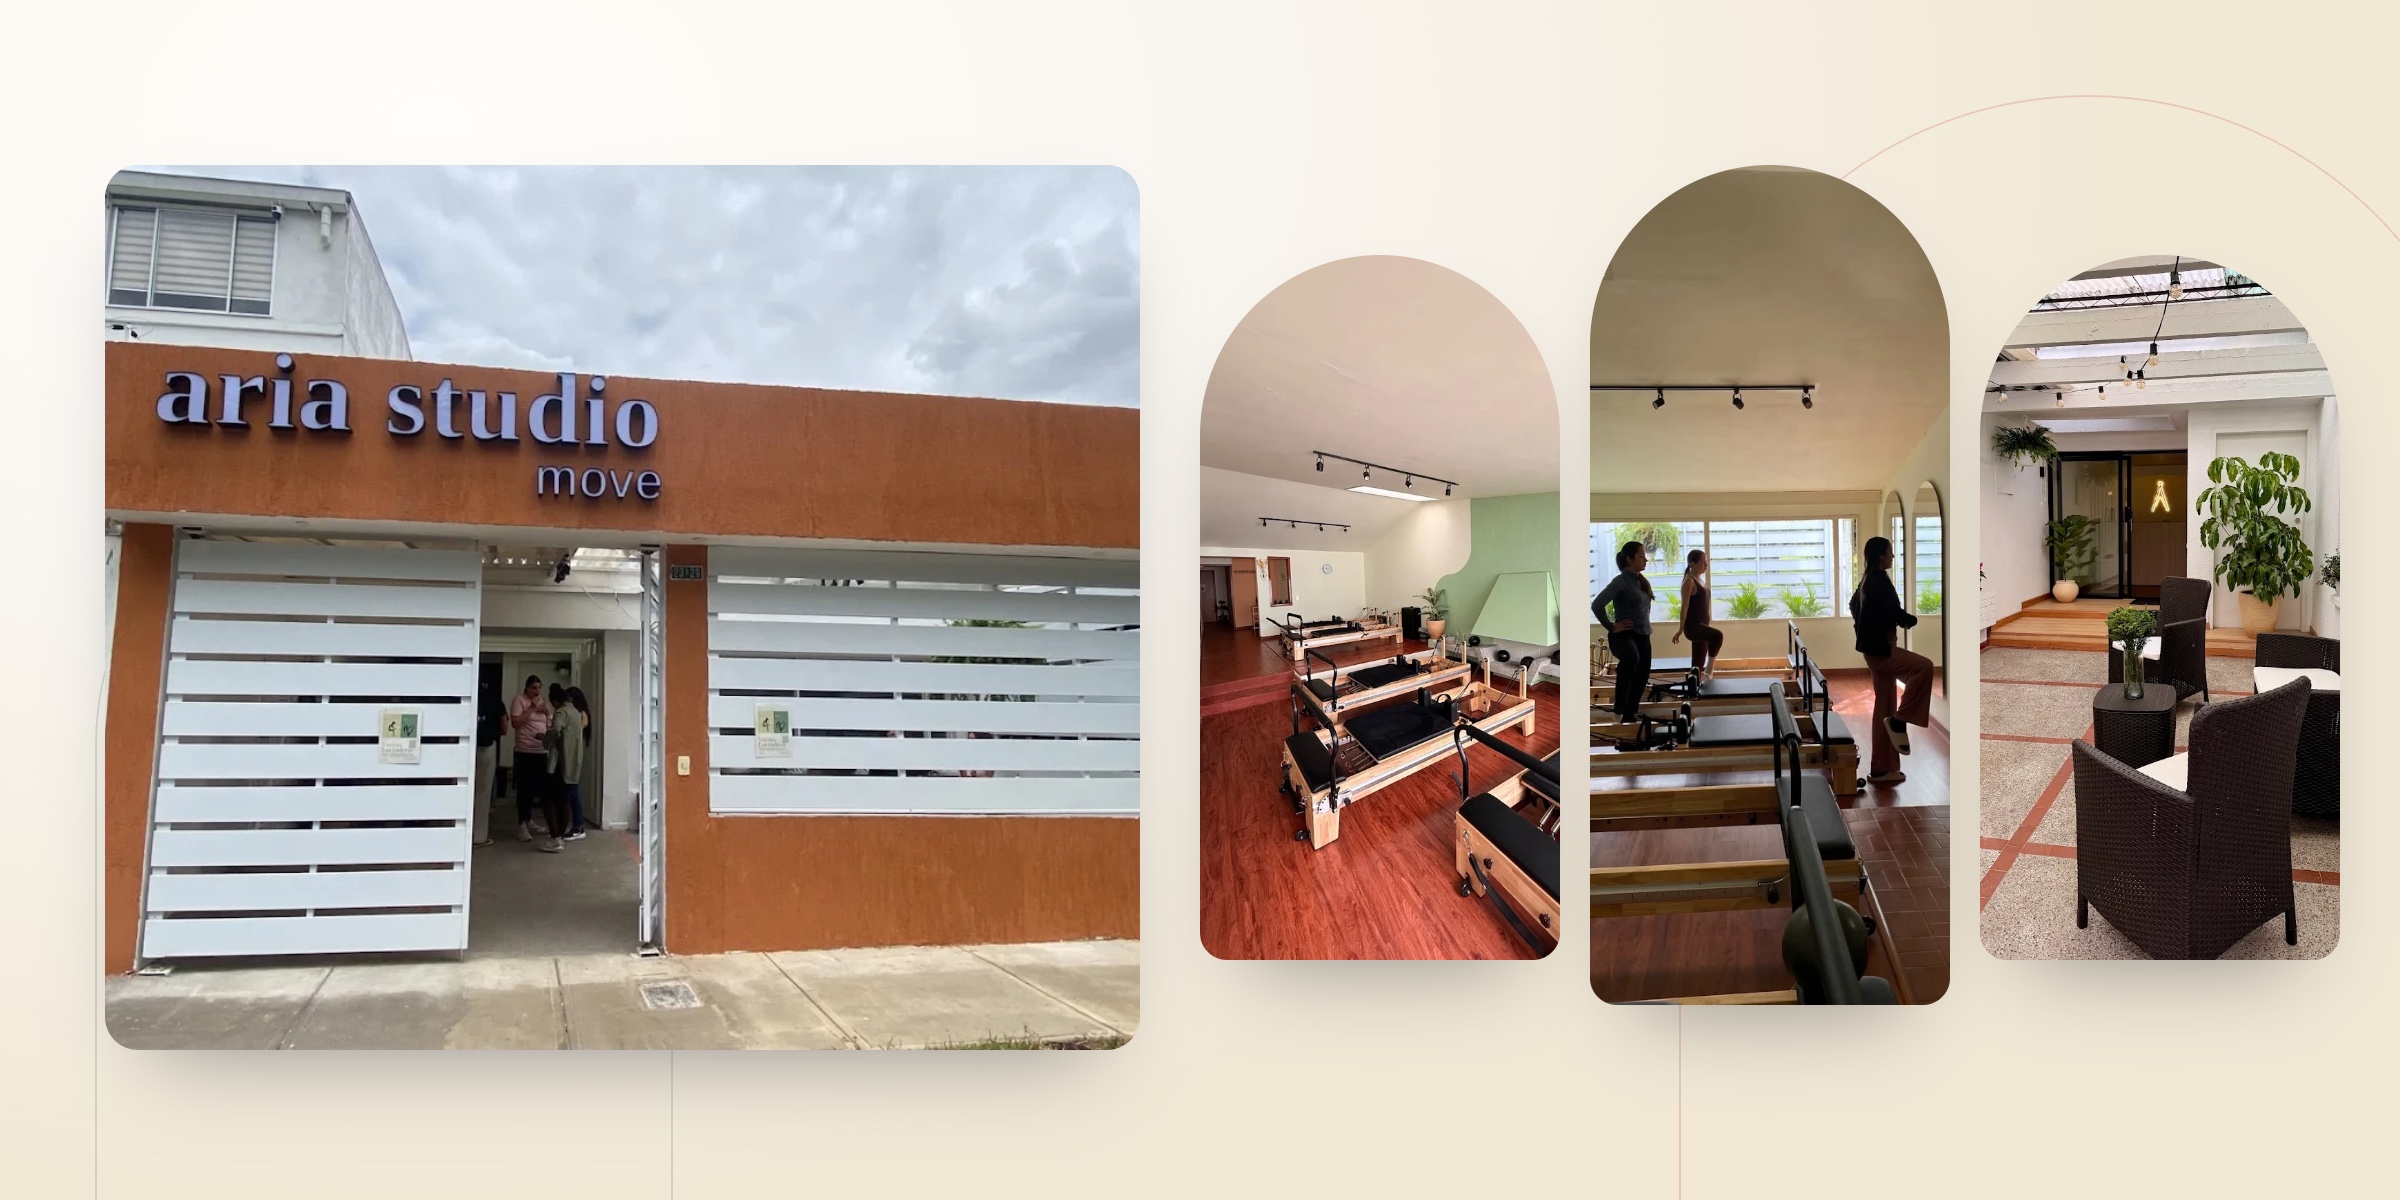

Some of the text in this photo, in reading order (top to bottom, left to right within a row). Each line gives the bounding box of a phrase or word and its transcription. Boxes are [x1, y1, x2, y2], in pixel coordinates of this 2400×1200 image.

[156, 352, 660, 448] aria studio
[536, 464, 663, 501] move
